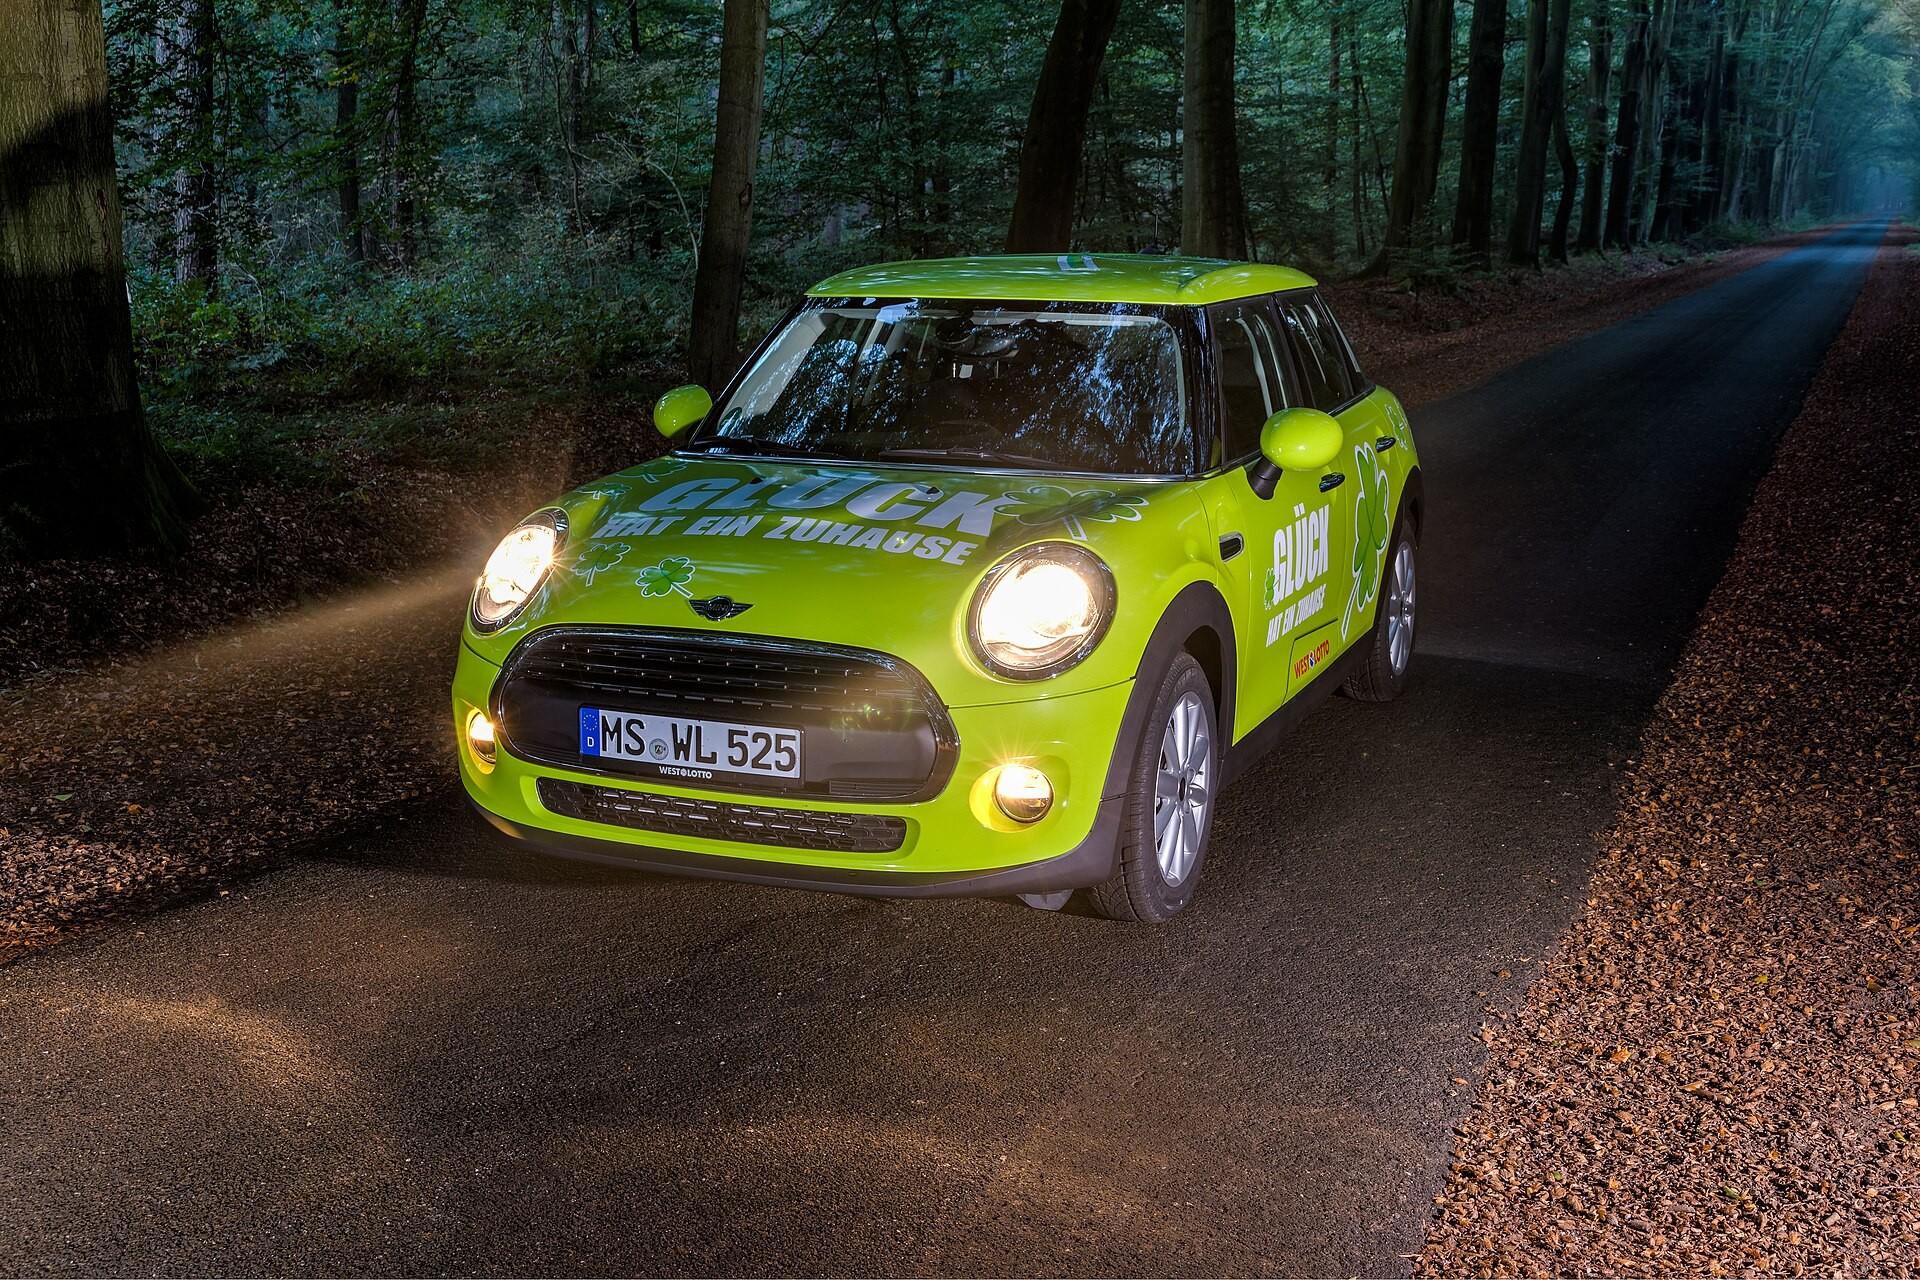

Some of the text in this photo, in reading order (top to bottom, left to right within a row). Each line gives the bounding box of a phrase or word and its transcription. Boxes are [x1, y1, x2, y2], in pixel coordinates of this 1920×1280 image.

[590, 515, 979, 566] HAT EIN ZUHAUSE
[1273, 502, 1330, 606] GLÜCK
[587, 736, 595, 747] D
[601, 715, 797, 772] MS WL 525
